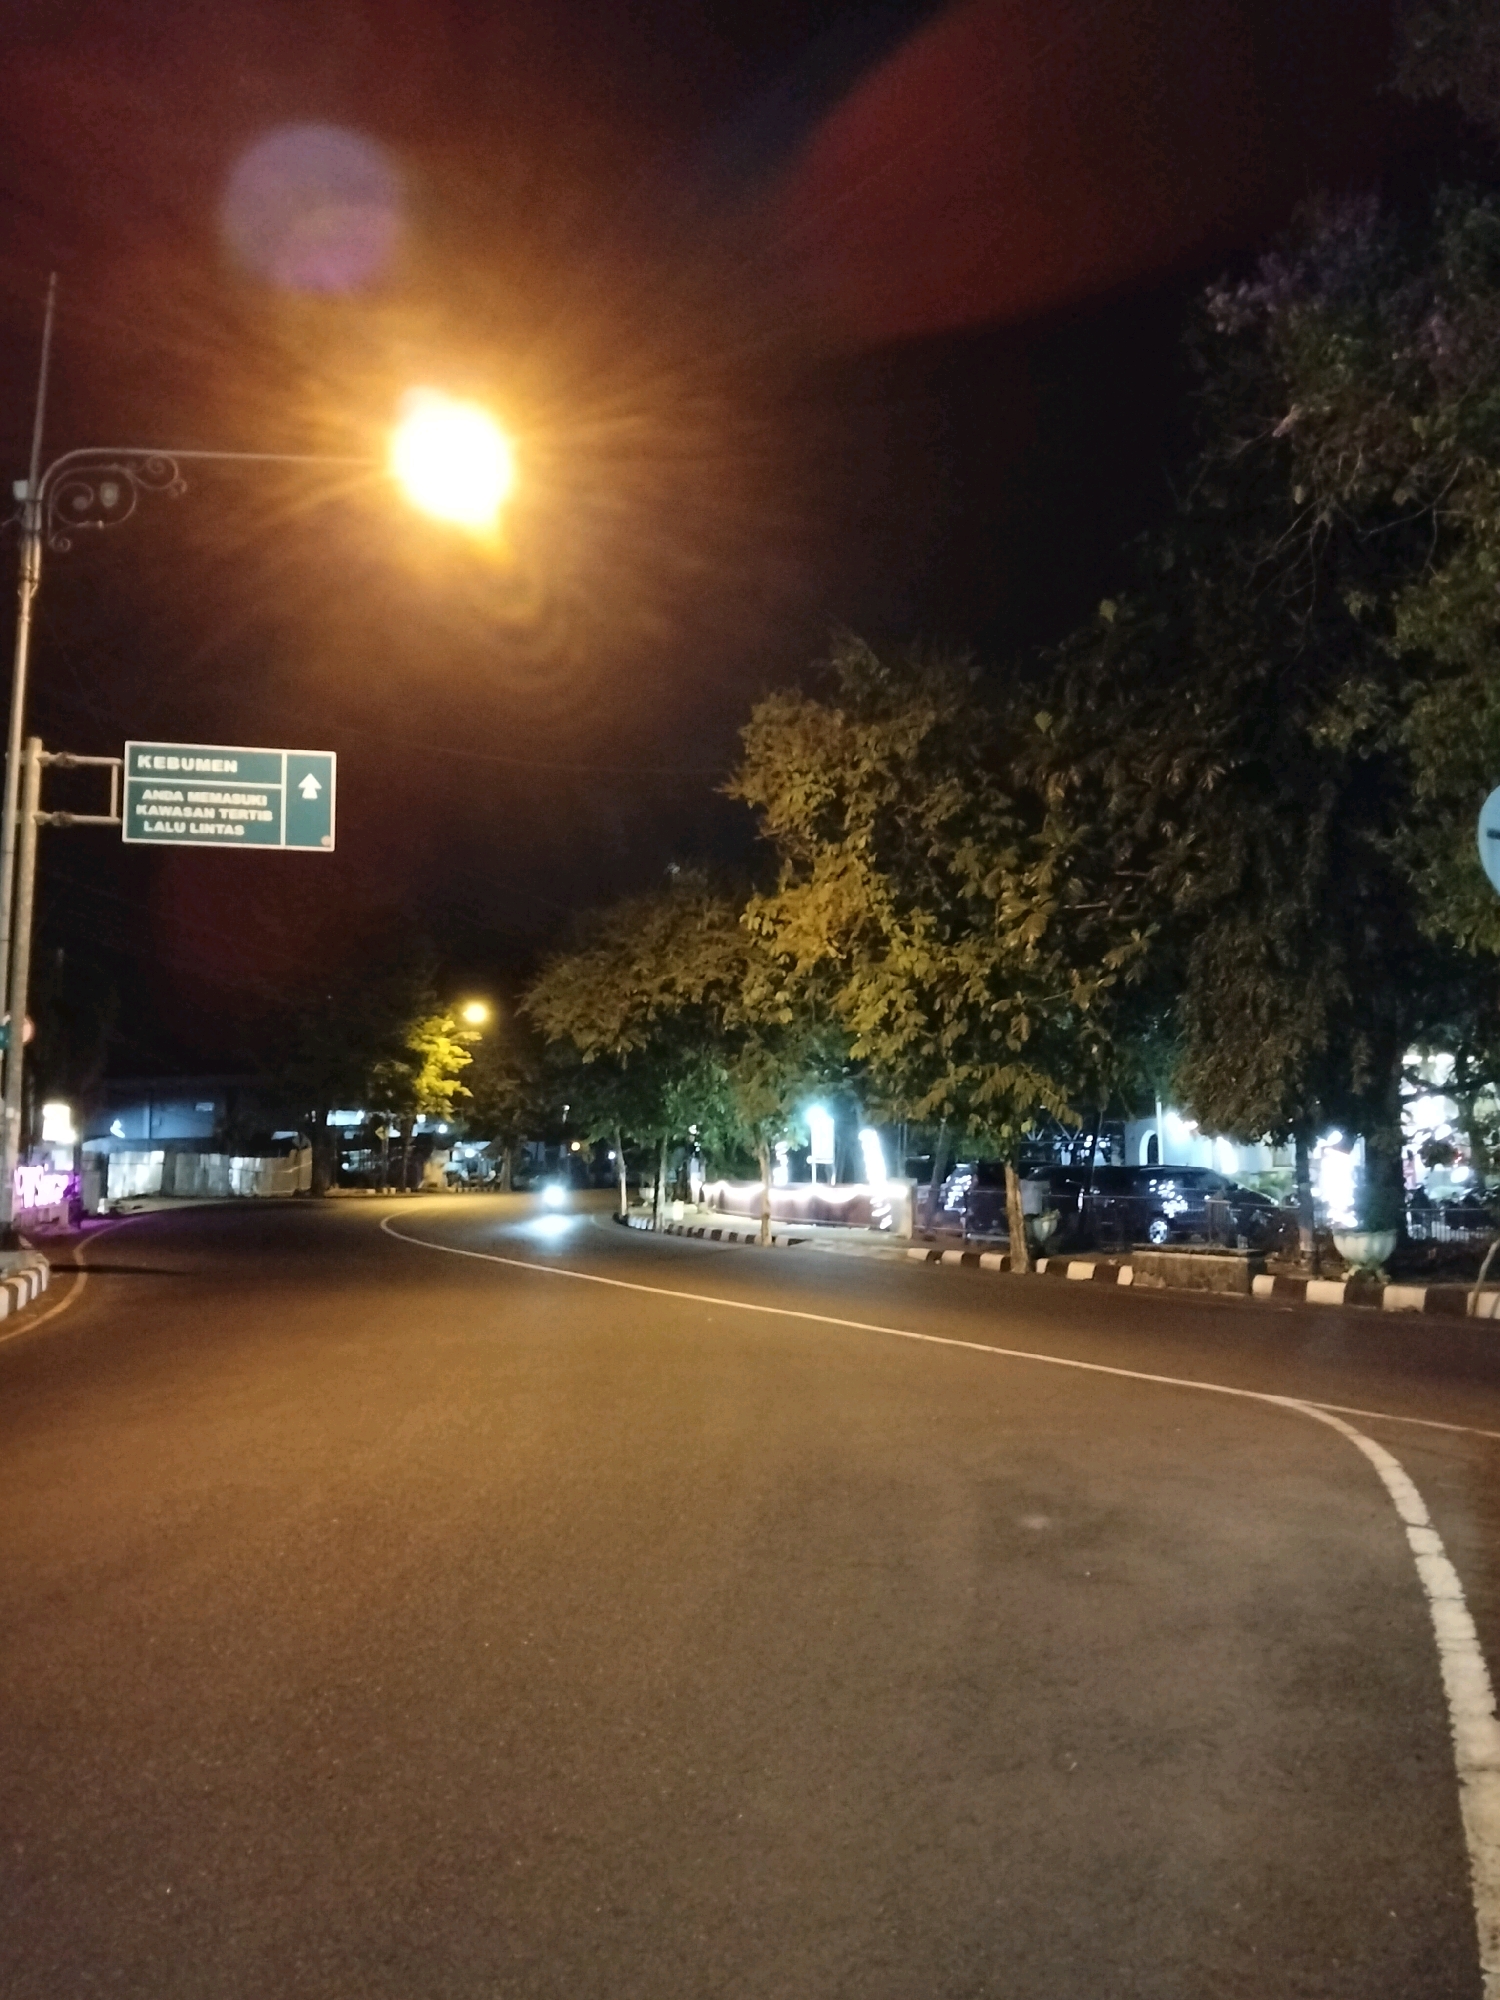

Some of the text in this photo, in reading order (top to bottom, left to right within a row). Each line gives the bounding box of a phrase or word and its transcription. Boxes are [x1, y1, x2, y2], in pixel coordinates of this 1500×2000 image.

[137, 754, 238, 773] KEBUMEN
[142, 789, 268, 806] ANDA MEMASUKI
[136, 805, 273, 821] KAWASAN TERTIB
[143, 820, 245, 836] LALU LINTAS
